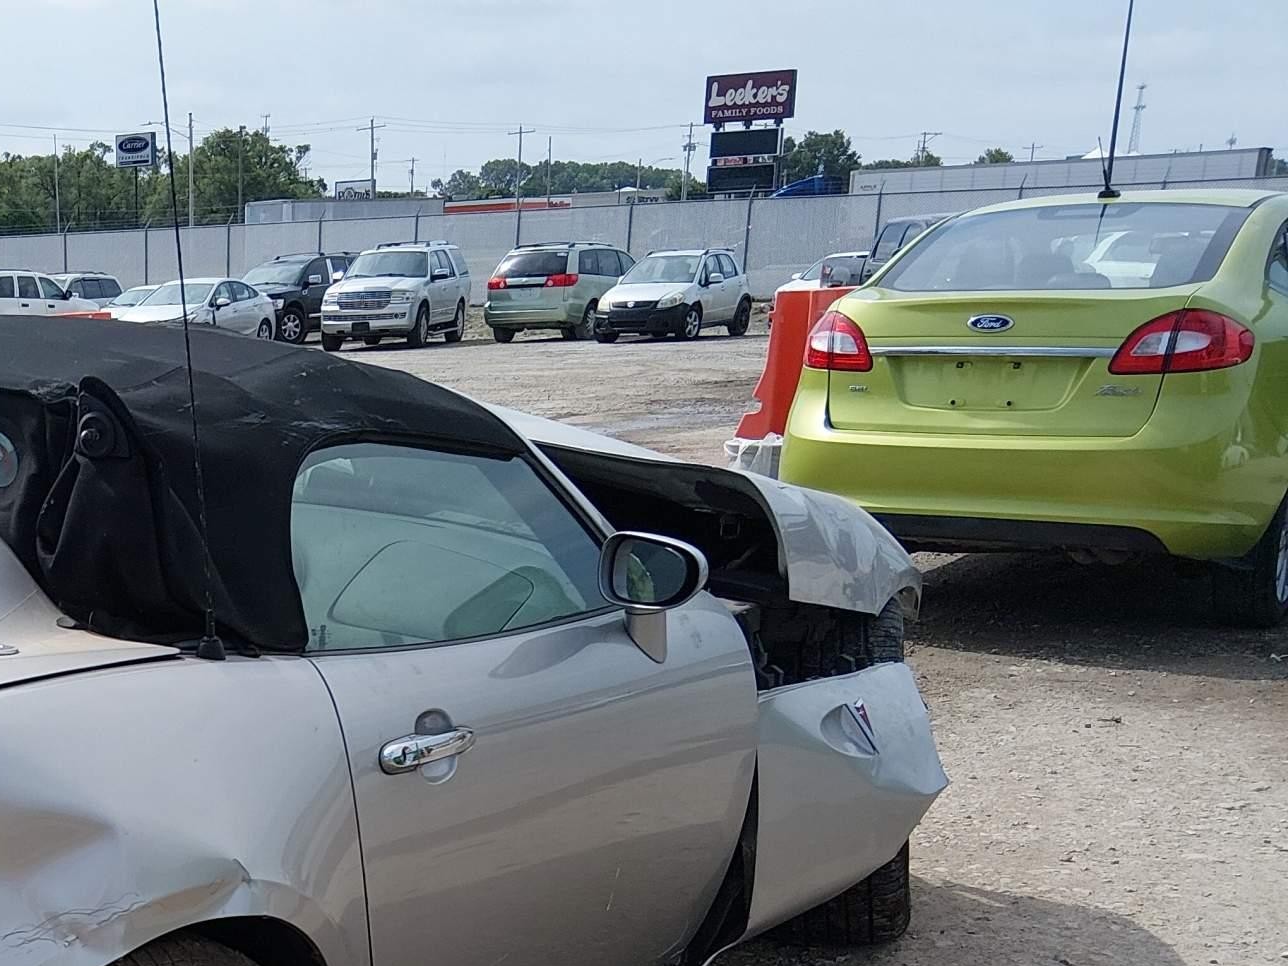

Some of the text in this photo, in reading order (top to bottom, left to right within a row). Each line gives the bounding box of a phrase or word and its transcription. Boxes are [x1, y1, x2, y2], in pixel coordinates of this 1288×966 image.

[708, 80, 790, 107] Leeker's
[711, 105, 784, 118] FAMILY FOODS
[122, 140, 147, 150] Carrier
[976, 317, 1003, 328] Ford
